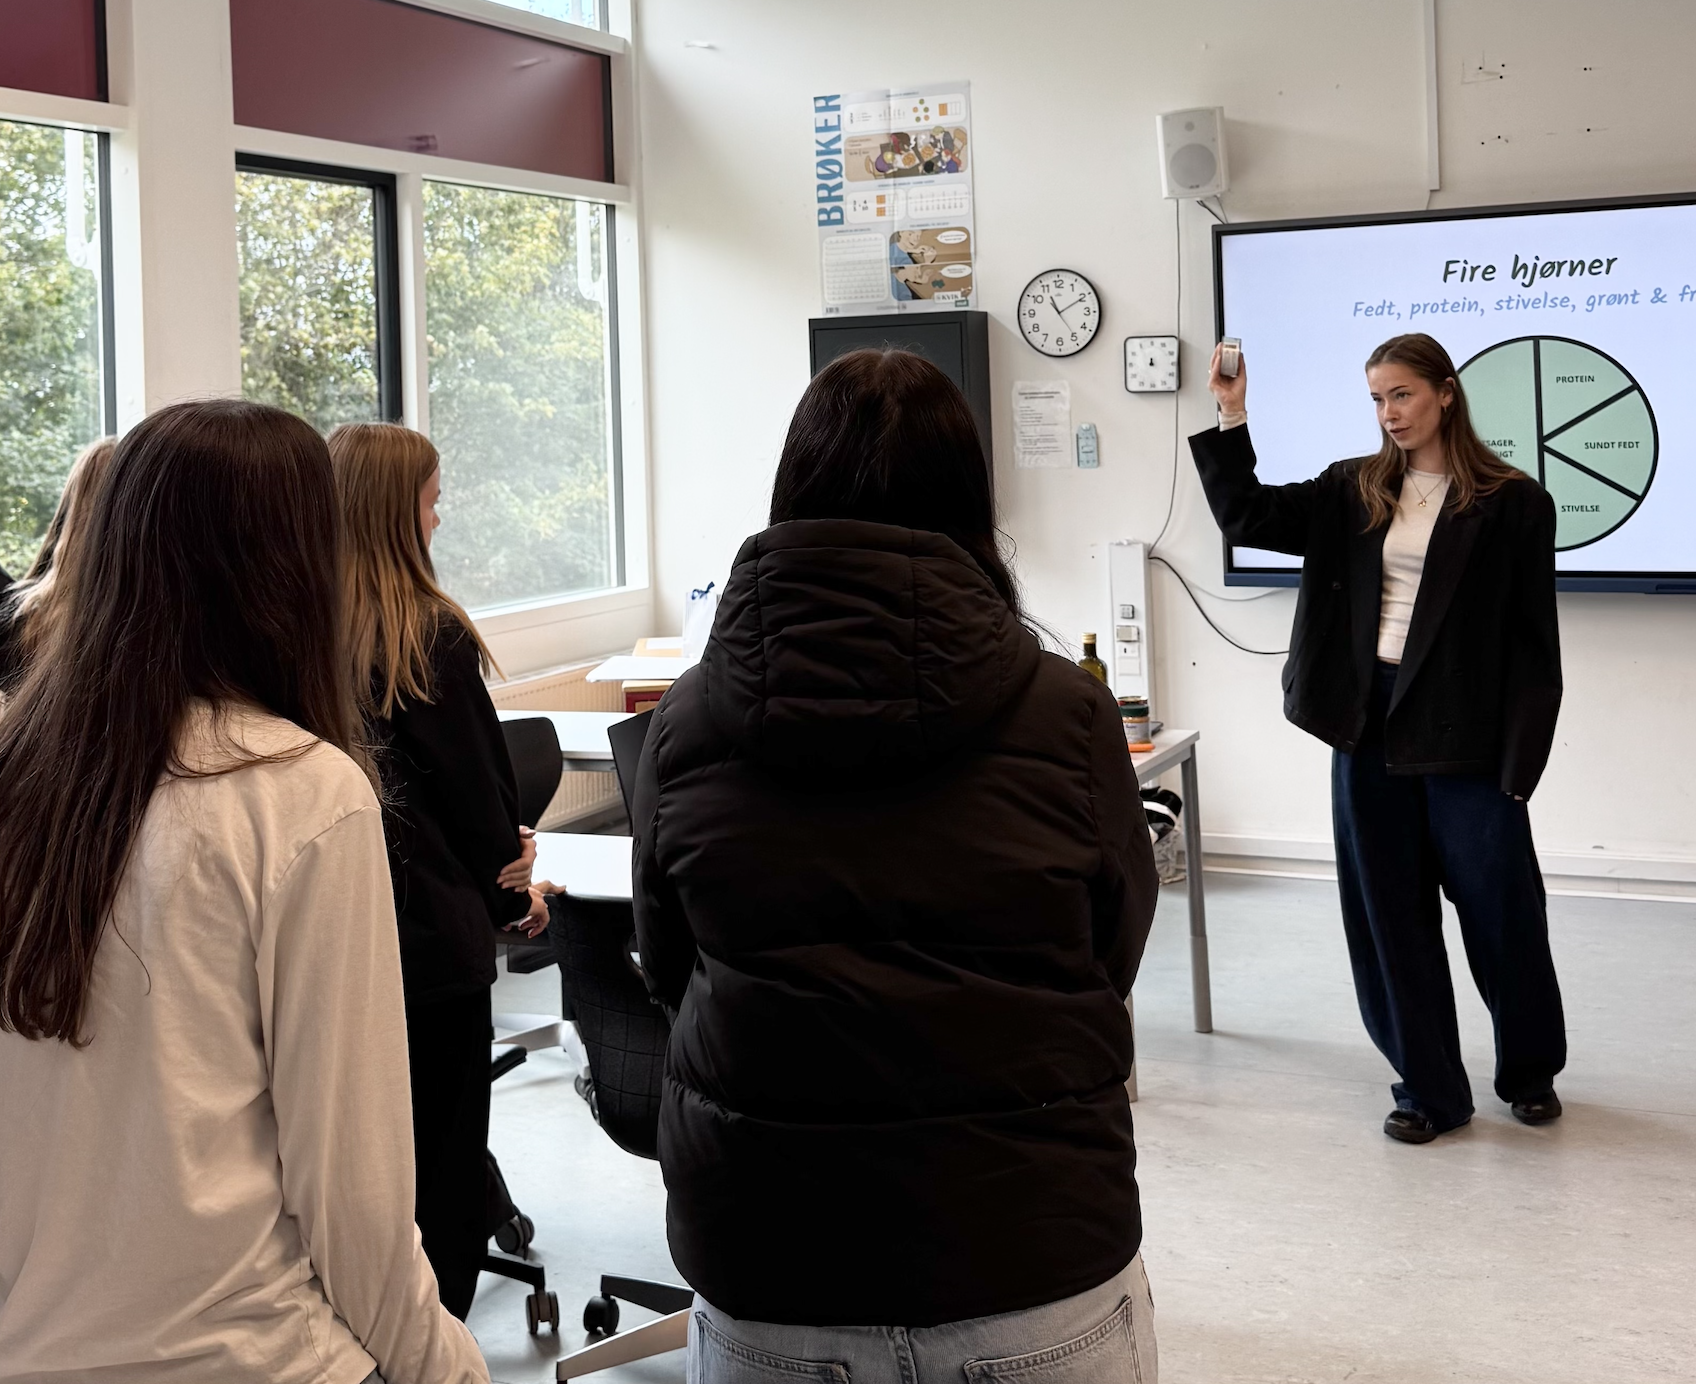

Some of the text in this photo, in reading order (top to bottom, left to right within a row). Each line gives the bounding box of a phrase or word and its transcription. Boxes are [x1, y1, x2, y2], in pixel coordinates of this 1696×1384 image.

[813, 94, 844, 227] BRØKER
[1442, 253, 1618, 288] Fire hjørner
[1041, 284, 1050, 293] 11
[1053, 279, 1064, 289] 12
[1069, 283, 1075, 292] 1
[1031, 294, 1044, 304] 10
[1078, 293, 1086, 302] 2
[1352, 299, 1402, 321] Fedt,
[1409, 297, 1485, 321] protein,
[1493, 290, 1577, 313] stivelse,
[1585, 288, 1641, 314] grønt
[1649, 286, 1668, 304] &
[1028, 309, 1036, 318] 9
[1083, 306, 1091, 316] 3
[1032, 323, 1040, 333] 8
[1080, 322, 1087, 331] 4
[1042, 333, 1049, 343] 7
[1055, 337, 1064, 347] 6
[1070, 332, 1078, 342] 5
[1555, 374, 1595, 384] PROTEIN
[1584, 440, 1641, 450] SUNDT FEDT
[1561, 504, 1601, 513] STIVELSE
